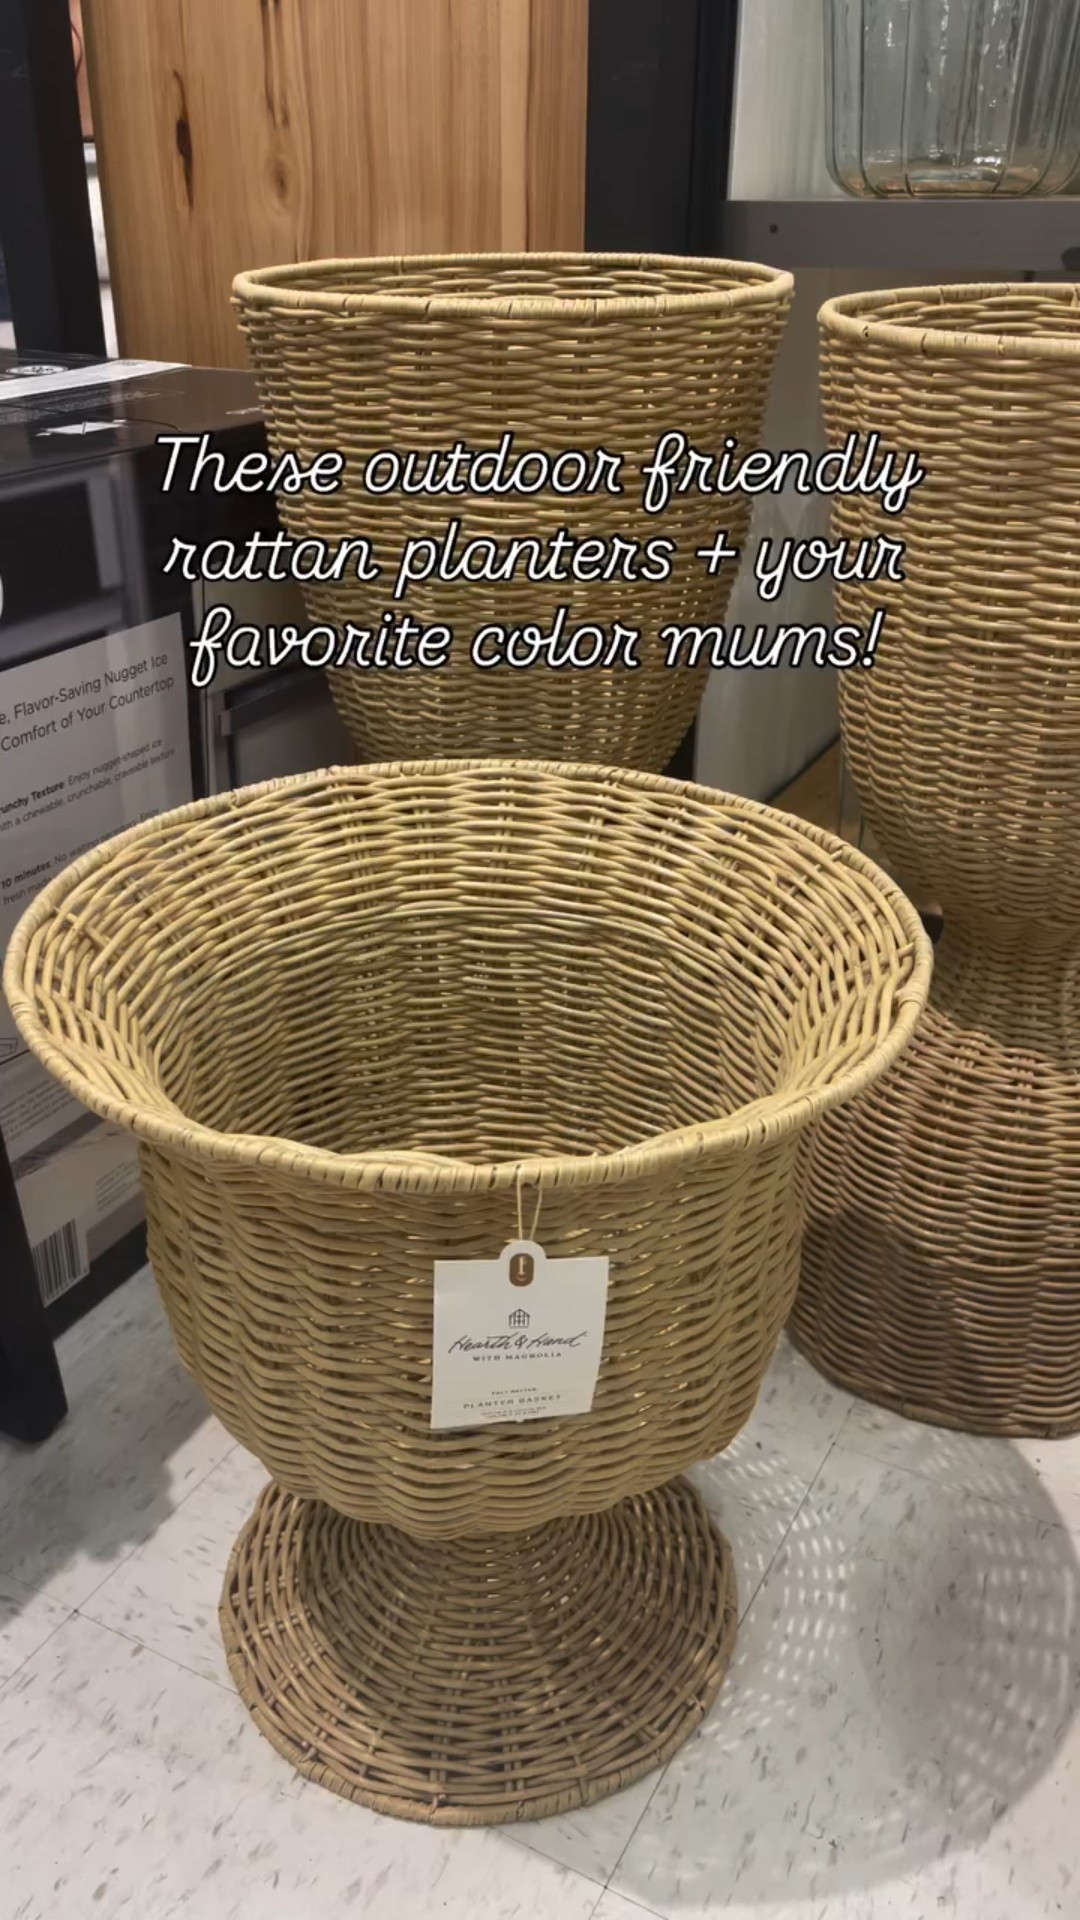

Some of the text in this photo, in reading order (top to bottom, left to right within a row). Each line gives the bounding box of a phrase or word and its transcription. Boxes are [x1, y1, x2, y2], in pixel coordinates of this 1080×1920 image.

[14, 678, 101, 720] Flavor-Saving
[104, 660, 148, 687] Nugget
[151, 653, 168, 669] Ice
[0, 676, 175, 752] Comfort of Your Countertop
[67, 770, 91, 786] Enjoy
[92, 744, 150, 775] nugget-shaped
[151, 738, 162, 749] ice
[150, 748, 176, 766] texture
[1, 877, 12, 889] 10
[54, 853, 67, 864] No
[448, 1330, 588, 1354] Hearth & Hand
[505, 1351, 562, 1360] MAGNOLIA
[463, 1399, 514, 1409] PLANTER
[518, 1394, 561, 1405] BASKET
